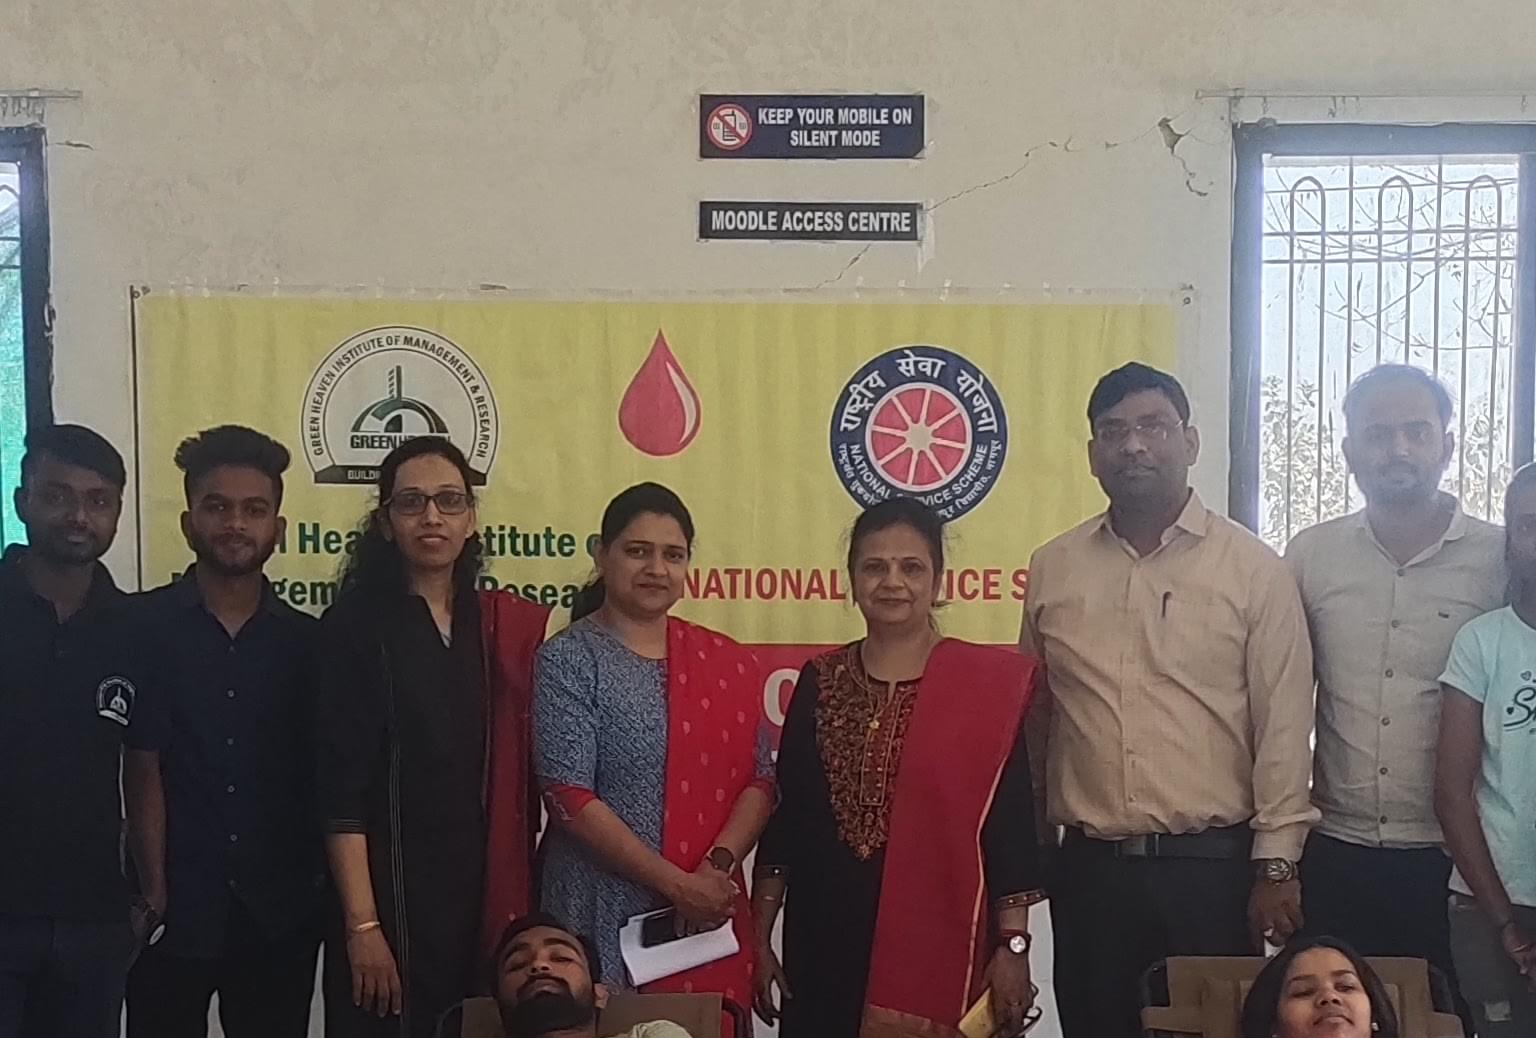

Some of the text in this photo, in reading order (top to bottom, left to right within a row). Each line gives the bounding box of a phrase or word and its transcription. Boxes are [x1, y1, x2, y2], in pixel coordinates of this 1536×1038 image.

[758, 108, 912, 125] KEEP YOUR MOBILE ON
[790, 130, 880, 147] SILENT MODE
[711, 210, 911, 233] MOODLE ACCESS CENTRE
[309, 335, 490, 458] GREEN HEAVEN INSTITUTE OF MANAGEMENT & RESEARCH
[896, 350, 946, 379] सेवा
[956, 369, 998, 433] योजना
[952, 444, 988, 495] SCHEME
[683, 568, 846, 600] NATIONAL
